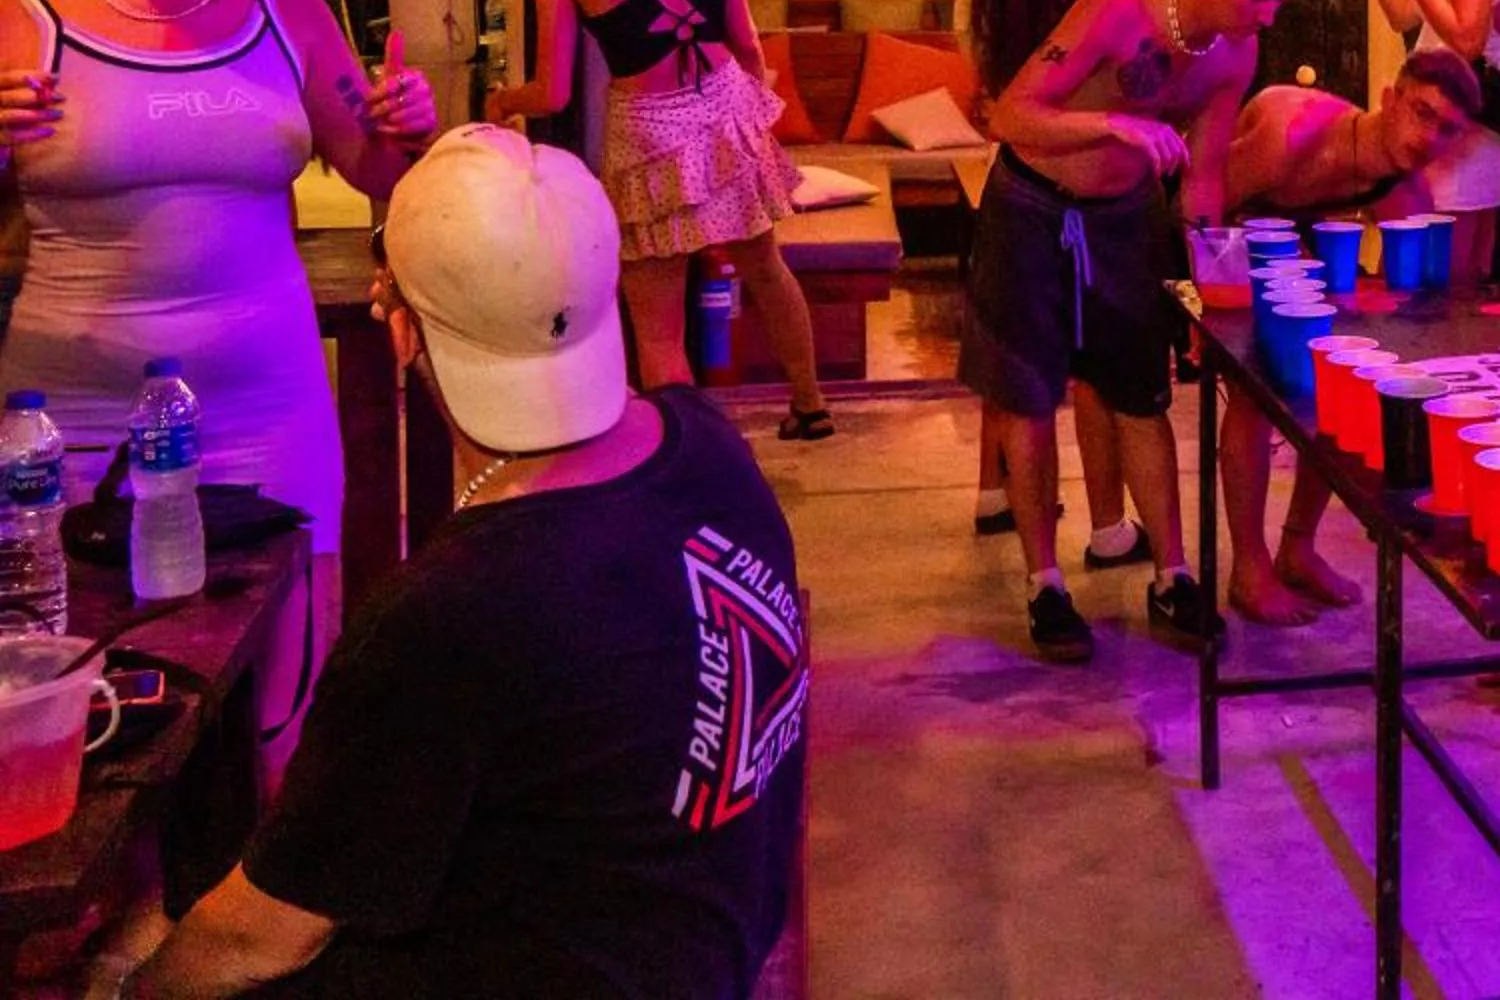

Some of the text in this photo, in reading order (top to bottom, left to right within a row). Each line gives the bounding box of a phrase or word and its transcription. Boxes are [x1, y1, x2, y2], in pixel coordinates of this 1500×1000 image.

[147, 87, 262, 120] FILA
[726, 548, 799, 630] PALACE
[689, 622, 730, 771] PALACE
